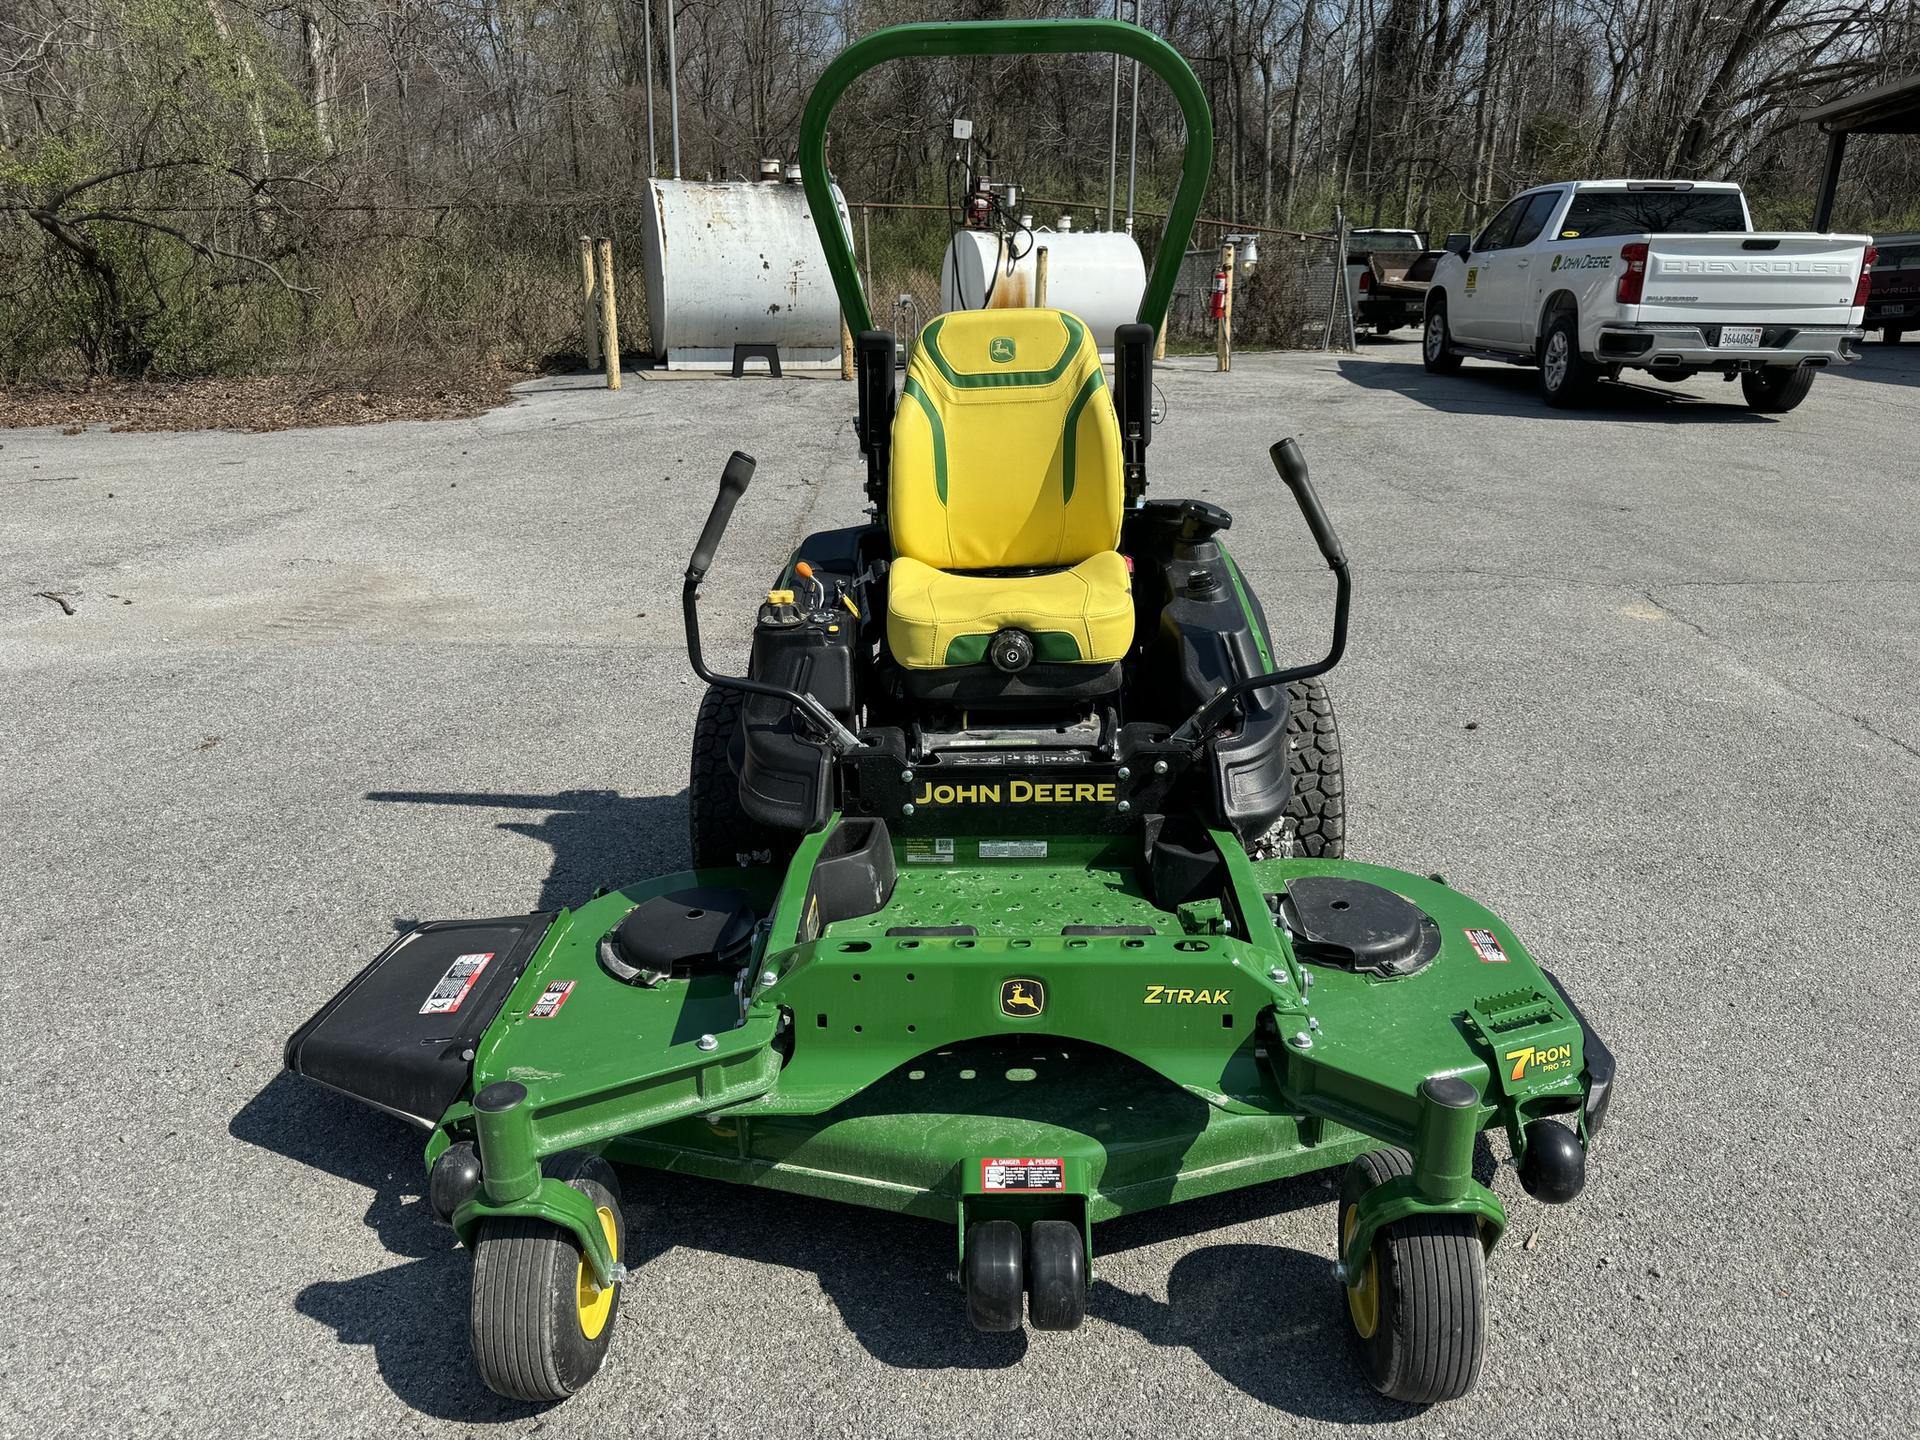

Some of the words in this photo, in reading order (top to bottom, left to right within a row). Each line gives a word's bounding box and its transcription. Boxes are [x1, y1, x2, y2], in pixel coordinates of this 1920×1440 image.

[1558, 255, 1581, 270] JOHN
[1581, 254, 1612, 269] DEERE
[1662, 260, 1849, 274] CHEVROLET
[915, 781, 1000, 804] JOHN
[1009, 780, 1116, 803] DEERE
[1142, 985, 1232, 1006] ZTRAK
[1506, 1046, 1536, 1081] 7
[1530, 1044, 1571, 1067] IRON
[1542, 1064, 1559, 1073] PRO
[1561, 1060, 1572, 1069] 72
